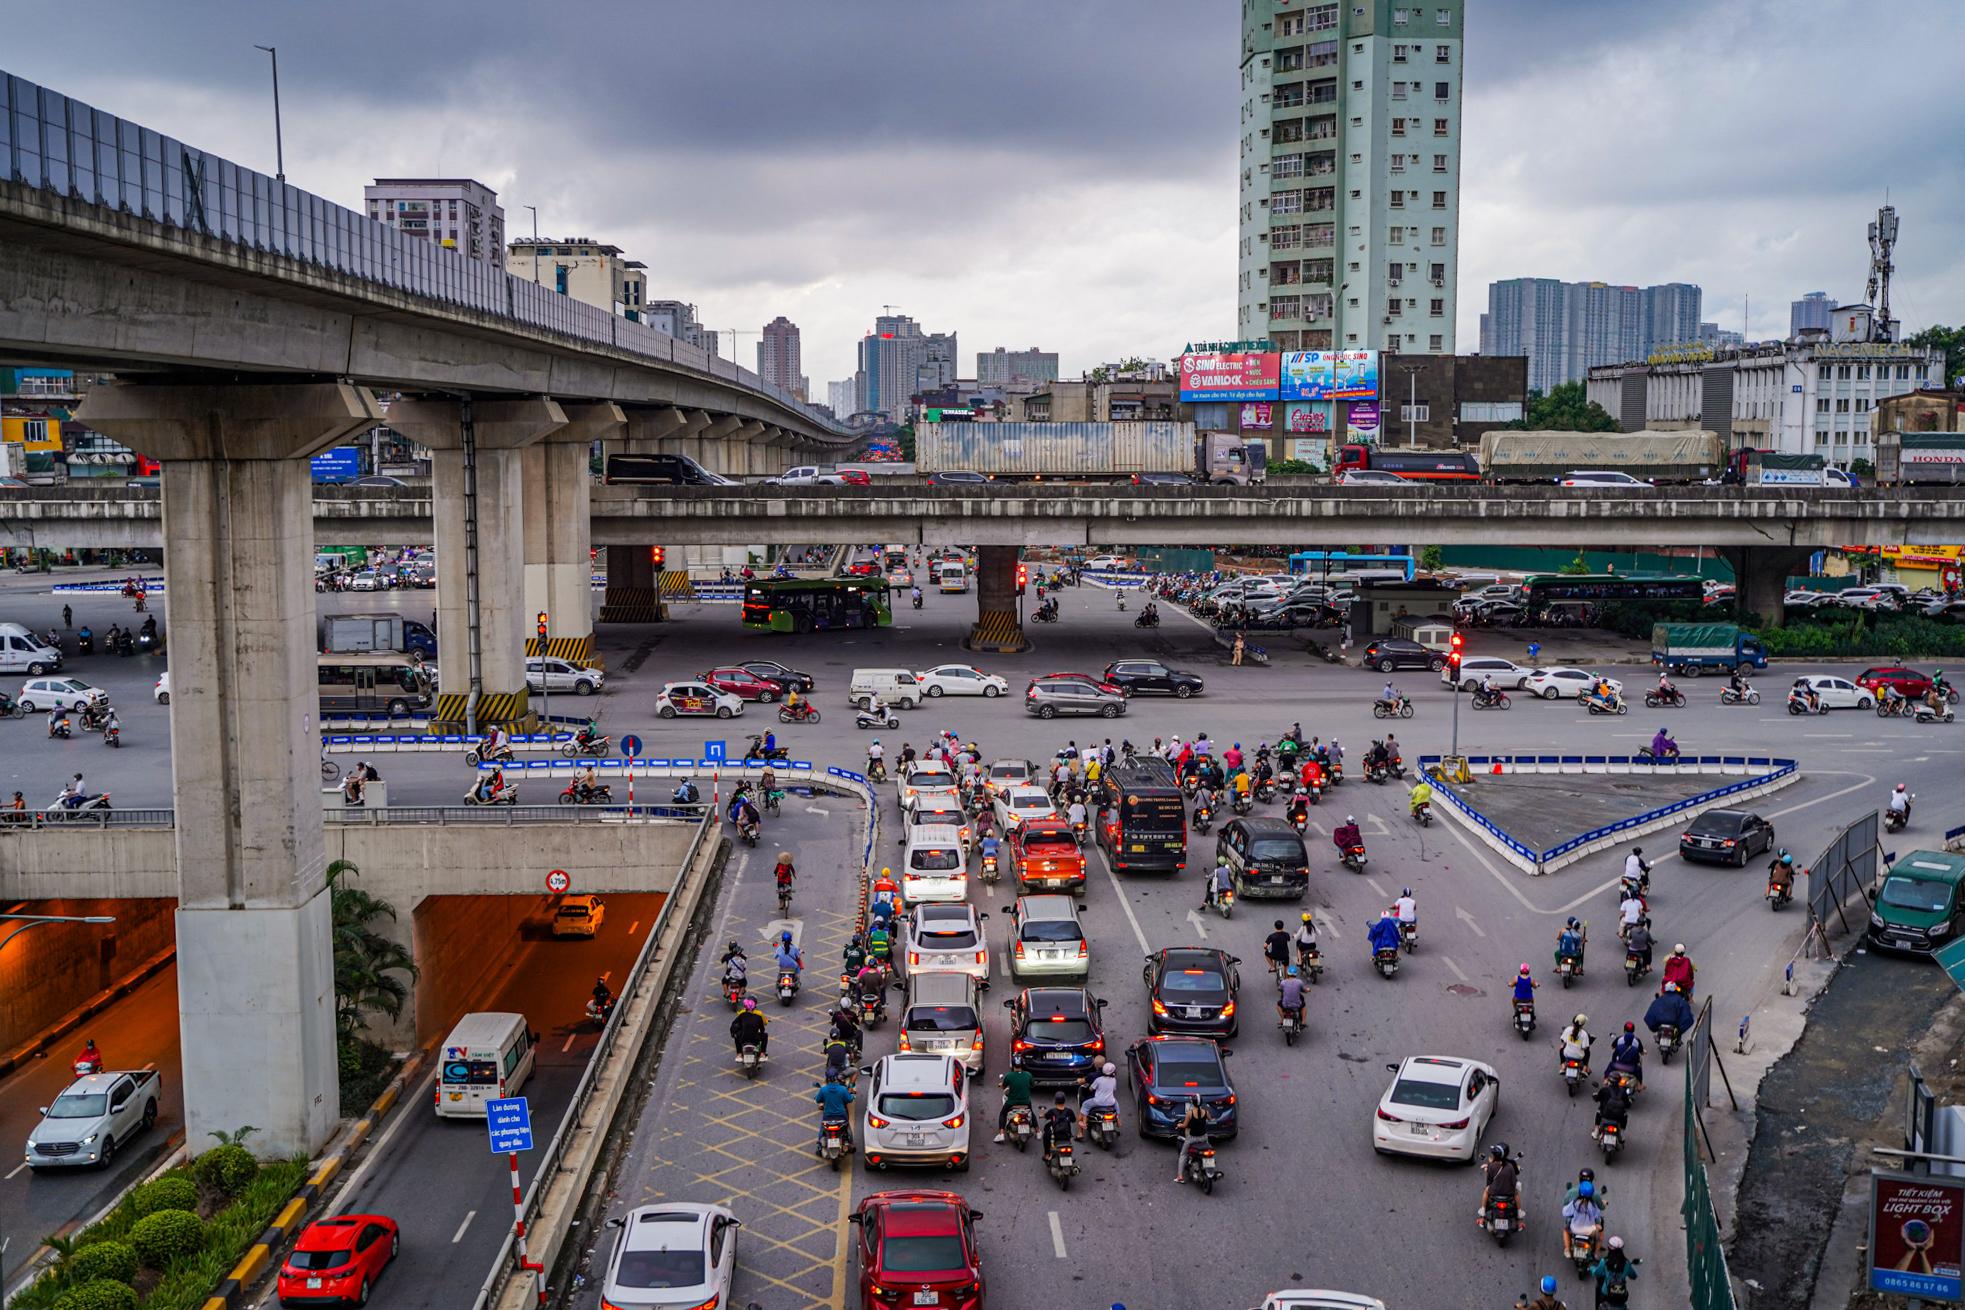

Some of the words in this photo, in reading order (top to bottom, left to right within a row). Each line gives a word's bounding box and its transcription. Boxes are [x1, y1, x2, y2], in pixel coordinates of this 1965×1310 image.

[1305, 353, 1320, 363] SP
[1195, 359, 1215, 371] SINO
[1216, 362, 1242, 370] ELECTRIC
[1202, 375, 1243, 386] VANLOCK
[1898, 1186, 1918, 1197] TIẾT
[1918, 1188, 1944, 1199] KIỆM
[1883, 1203, 1922, 1214] LIGHT
[1922, 1205, 1952, 1215] BOX
